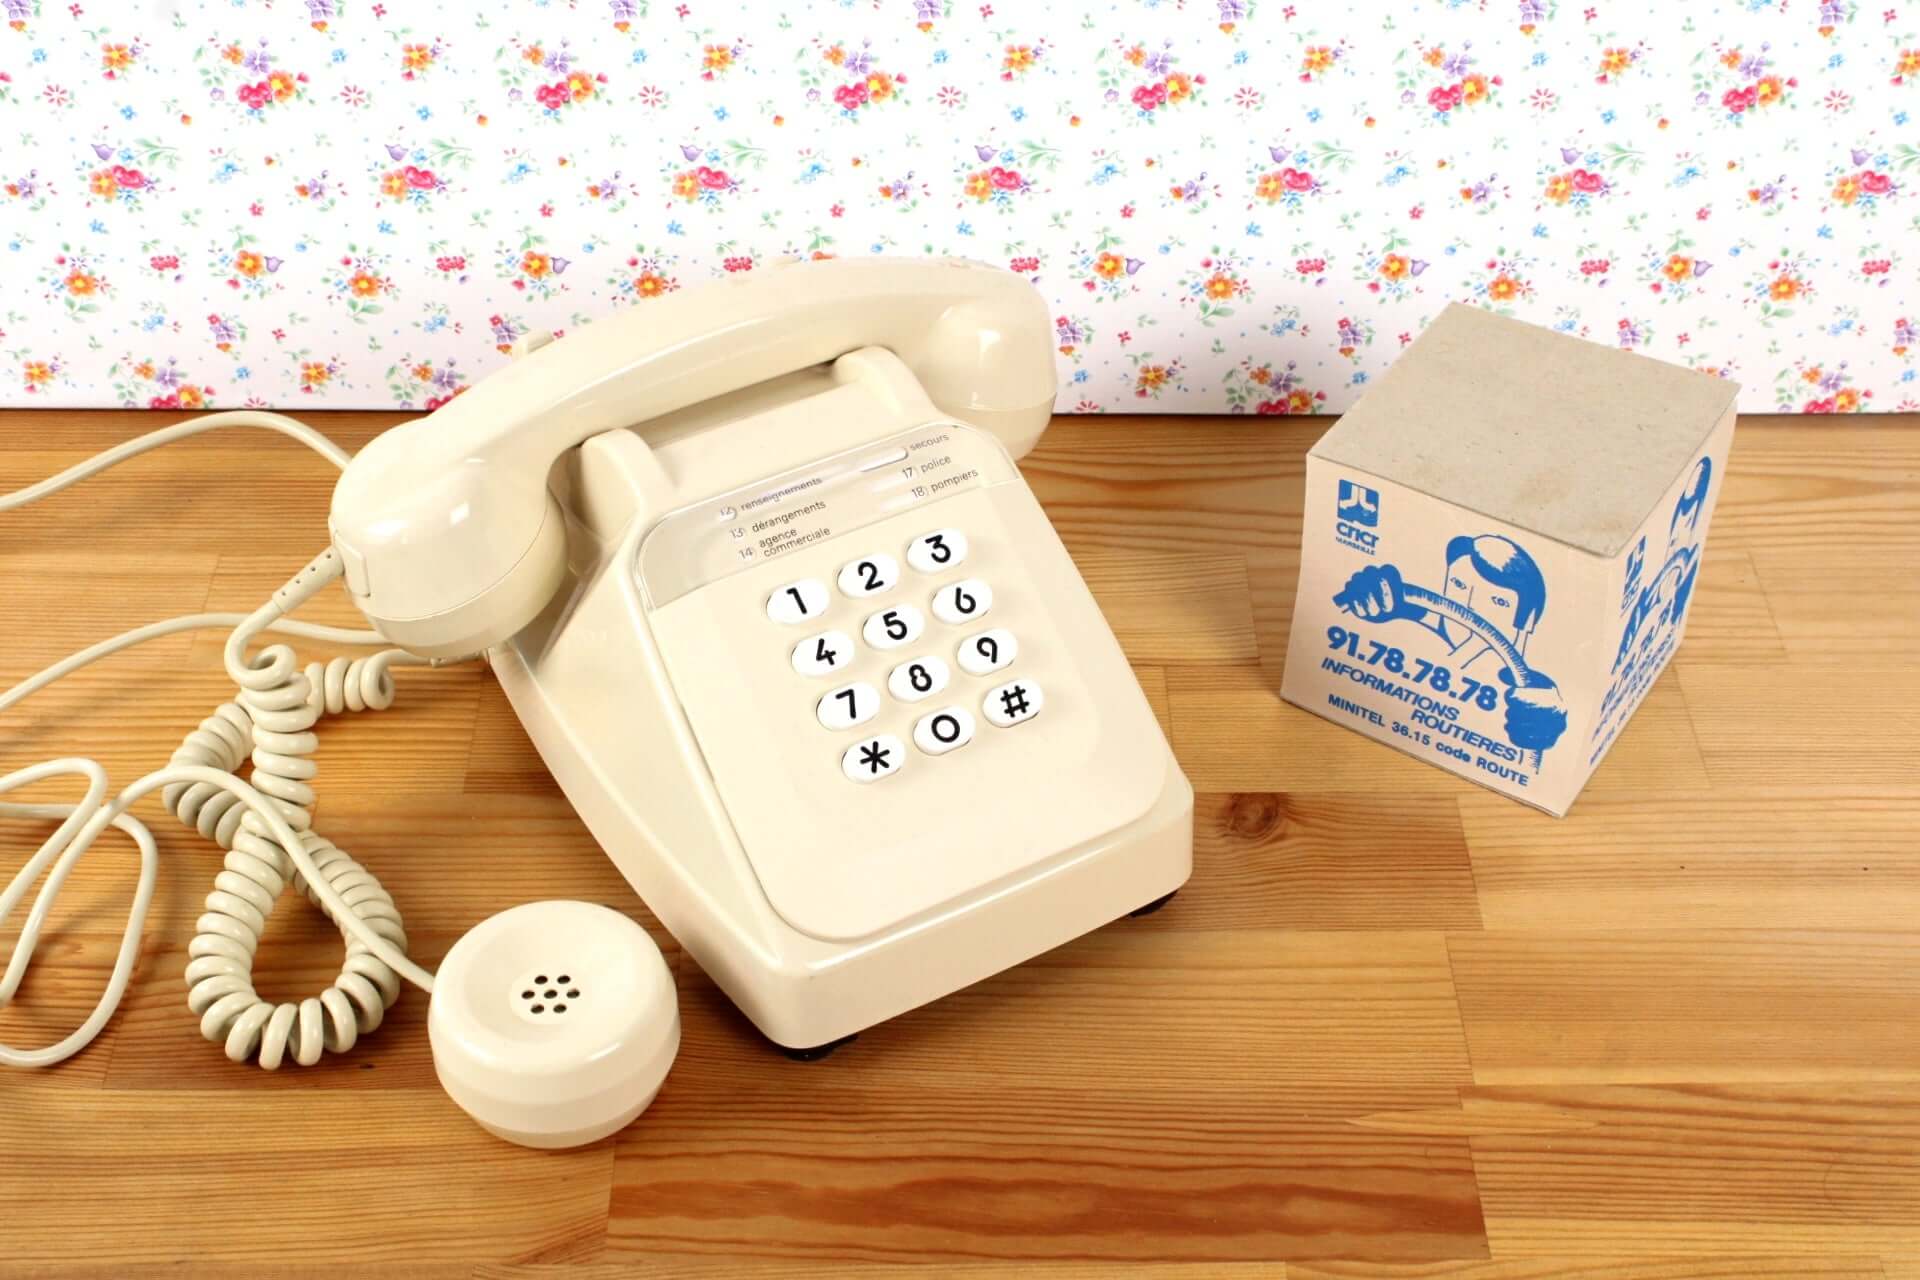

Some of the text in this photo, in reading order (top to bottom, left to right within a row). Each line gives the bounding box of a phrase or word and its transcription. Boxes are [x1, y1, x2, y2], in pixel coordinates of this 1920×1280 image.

[910, 433, 950, 451] secours
[903, 455, 951, 480] 17 police
[912, 469, 979, 499] 18 pompiers
[741, 477, 823, 512] renseignements
[731, 500, 827, 539] 13 dérangements
[740, 526, 831, 560] 14 commerciale
[760, 528, 798, 549] agence
[786, 534, 951, 614] 1 2 3
[815, 586, 977, 666] 4 5 6
[835, 636, 998, 719] 7 8 9
[1326, 625, 1499, 712] 91.78.78.78
[1000, 685, 1030, 718] #
[1321, 656, 1461, 722] INFORMATIONS
[1328, 693, 1530, 787] MINITEL 36.15 code ROUTE
